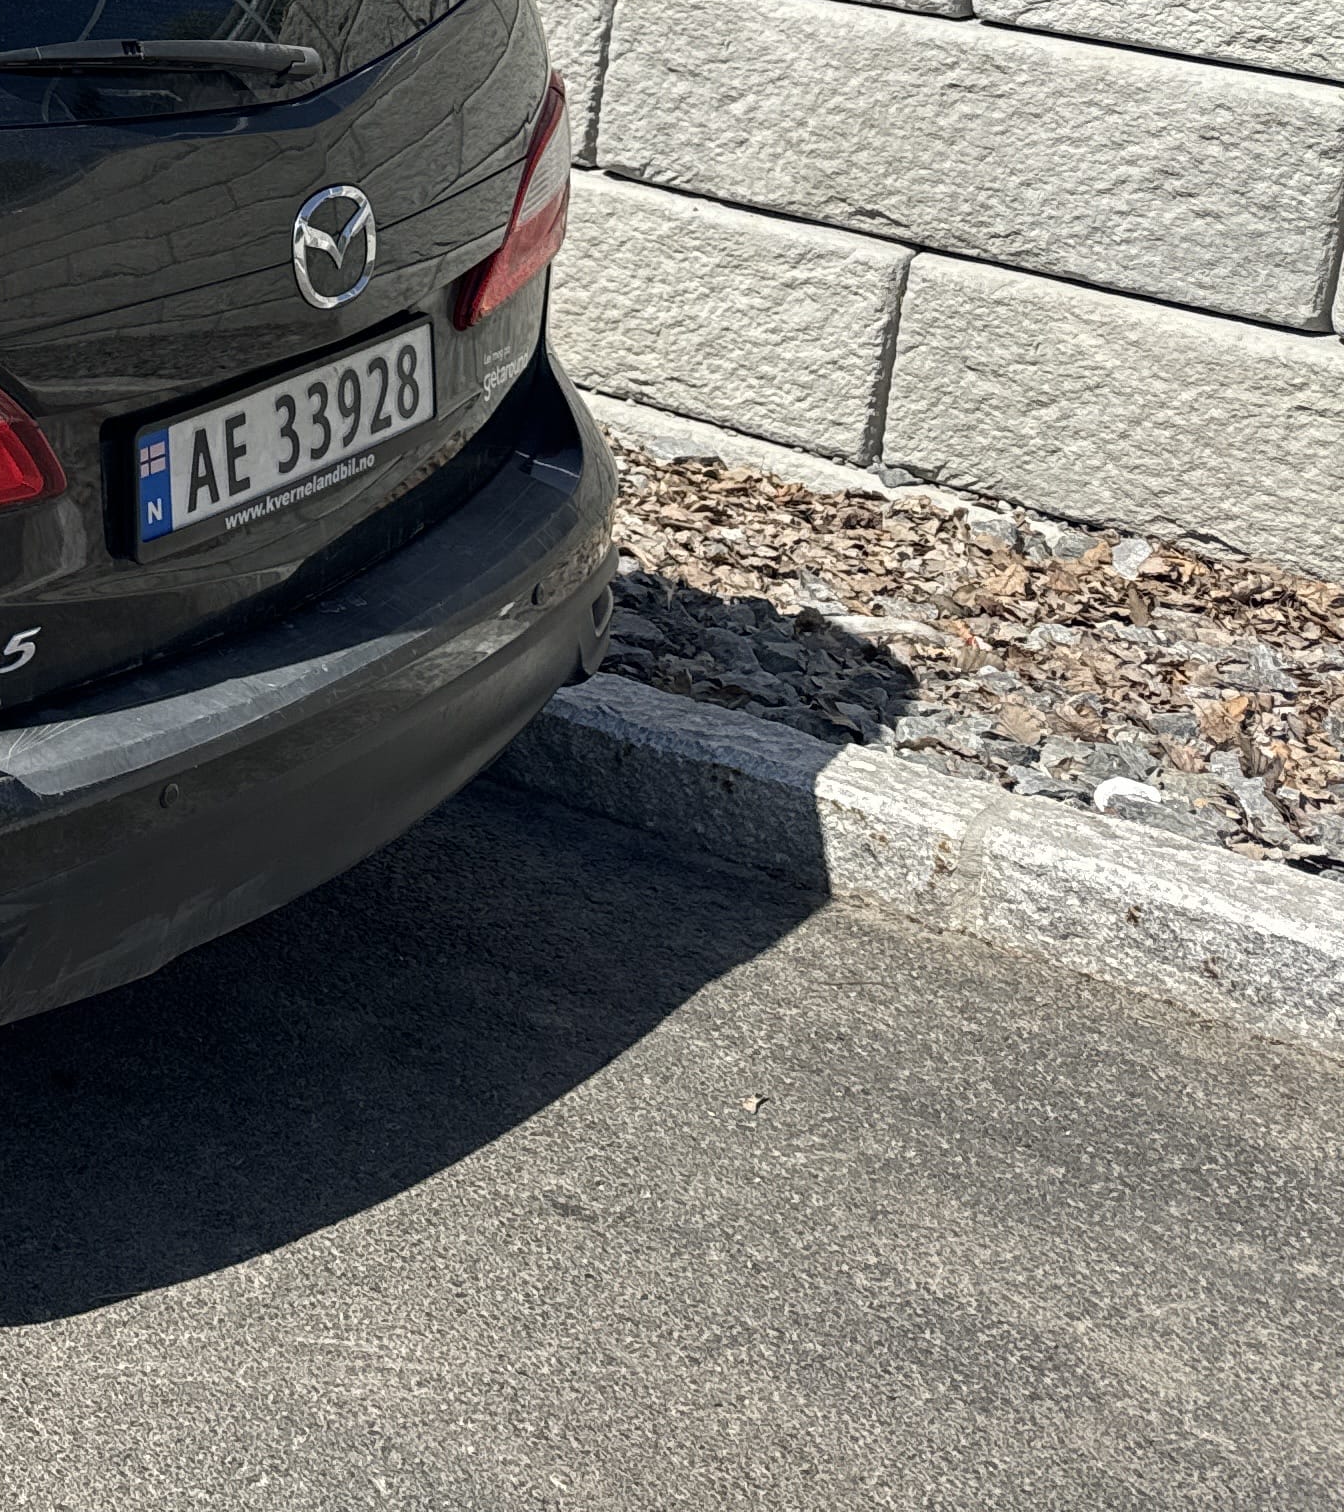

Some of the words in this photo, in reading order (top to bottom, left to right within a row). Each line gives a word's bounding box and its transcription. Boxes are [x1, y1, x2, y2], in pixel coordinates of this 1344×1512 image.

[147, 498, 163, 524] N
[187, 412, 251, 515] AE
[274, 344, 420, 474] 33928
[224, 453, 376, 531] www.kvernelandbil.no
